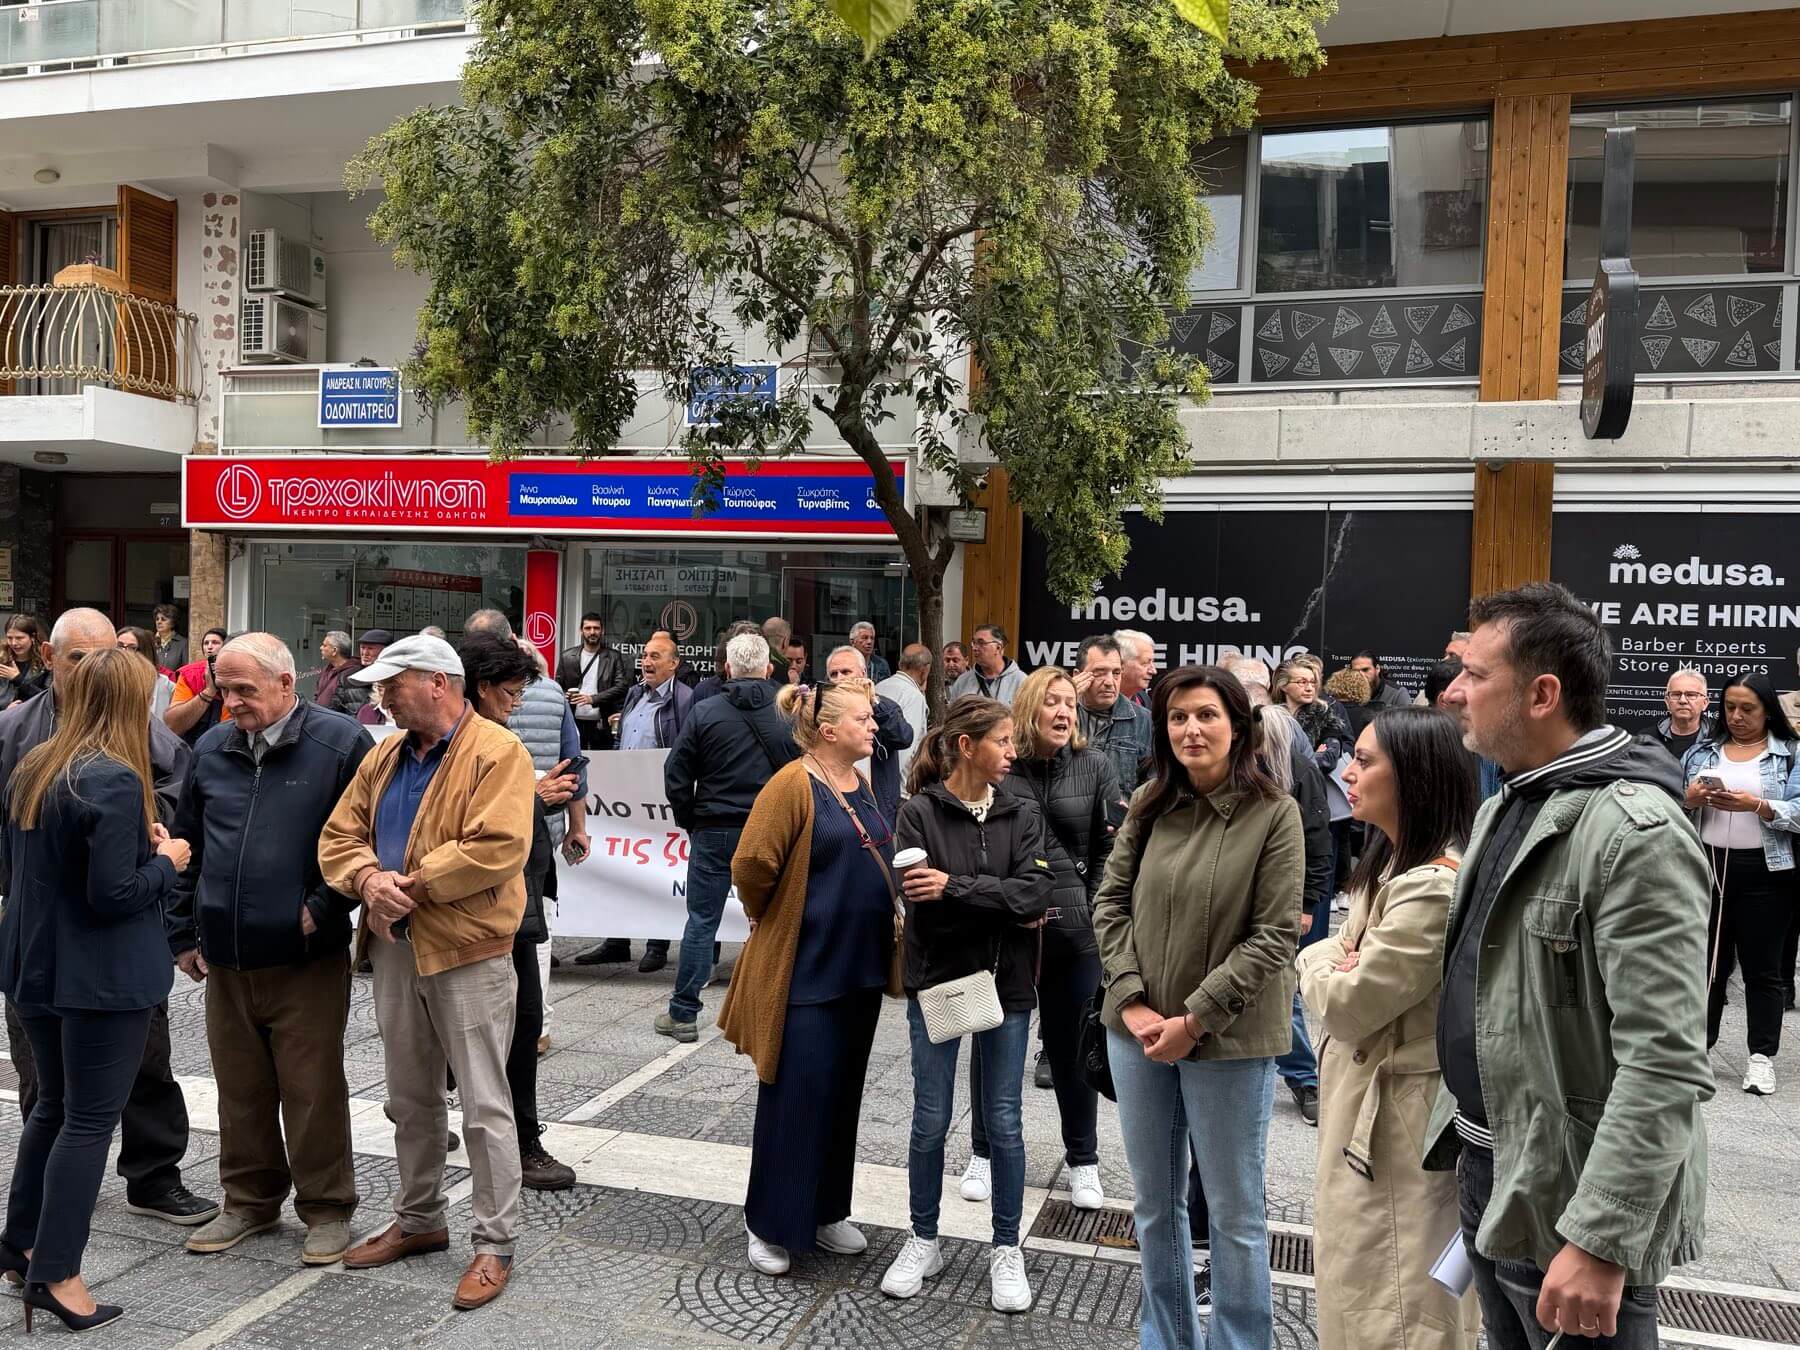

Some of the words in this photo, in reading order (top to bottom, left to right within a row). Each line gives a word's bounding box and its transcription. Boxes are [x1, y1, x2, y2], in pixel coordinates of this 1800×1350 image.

[326, 377, 354, 390] ΑΝΔΡΕΑΣ
[325, 402, 394, 420] ΟΔΟΝΤΙΑΤΡΕΙΟ
[520, 484, 538, 494] Άννα
[592, 484, 625, 495] Βασιλική
[648, 485, 679, 497] Ιωάννης
[723, 486, 756, 498] Γιώργος
[797, 486, 840, 498] Σωκράτης
[520, 495, 578, 506] Μαυροπούλου
[797, 498, 850, 511] Τυρναβίτης
[293, 508, 339, 518] ΚΕΝΤΡΟ
[345, 509, 429, 520] ΕΚΠΑΙΔΕΥΣΗΣ
[436, 510, 486, 520] ΟΔΗΓΩΝ
[1609, 556, 1785, 586] medusa.
[1630, 602, 1699, 626] ARE
[1622, 637, 1686, 653] Barber
[1696, 639, 1767, 656] Experts
[1025, 641, 1081, 667] WE
[1619, 657, 1669, 673] Store
[1679, 660, 1769, 677] Managers
[605, 837, 652, 865] τις
